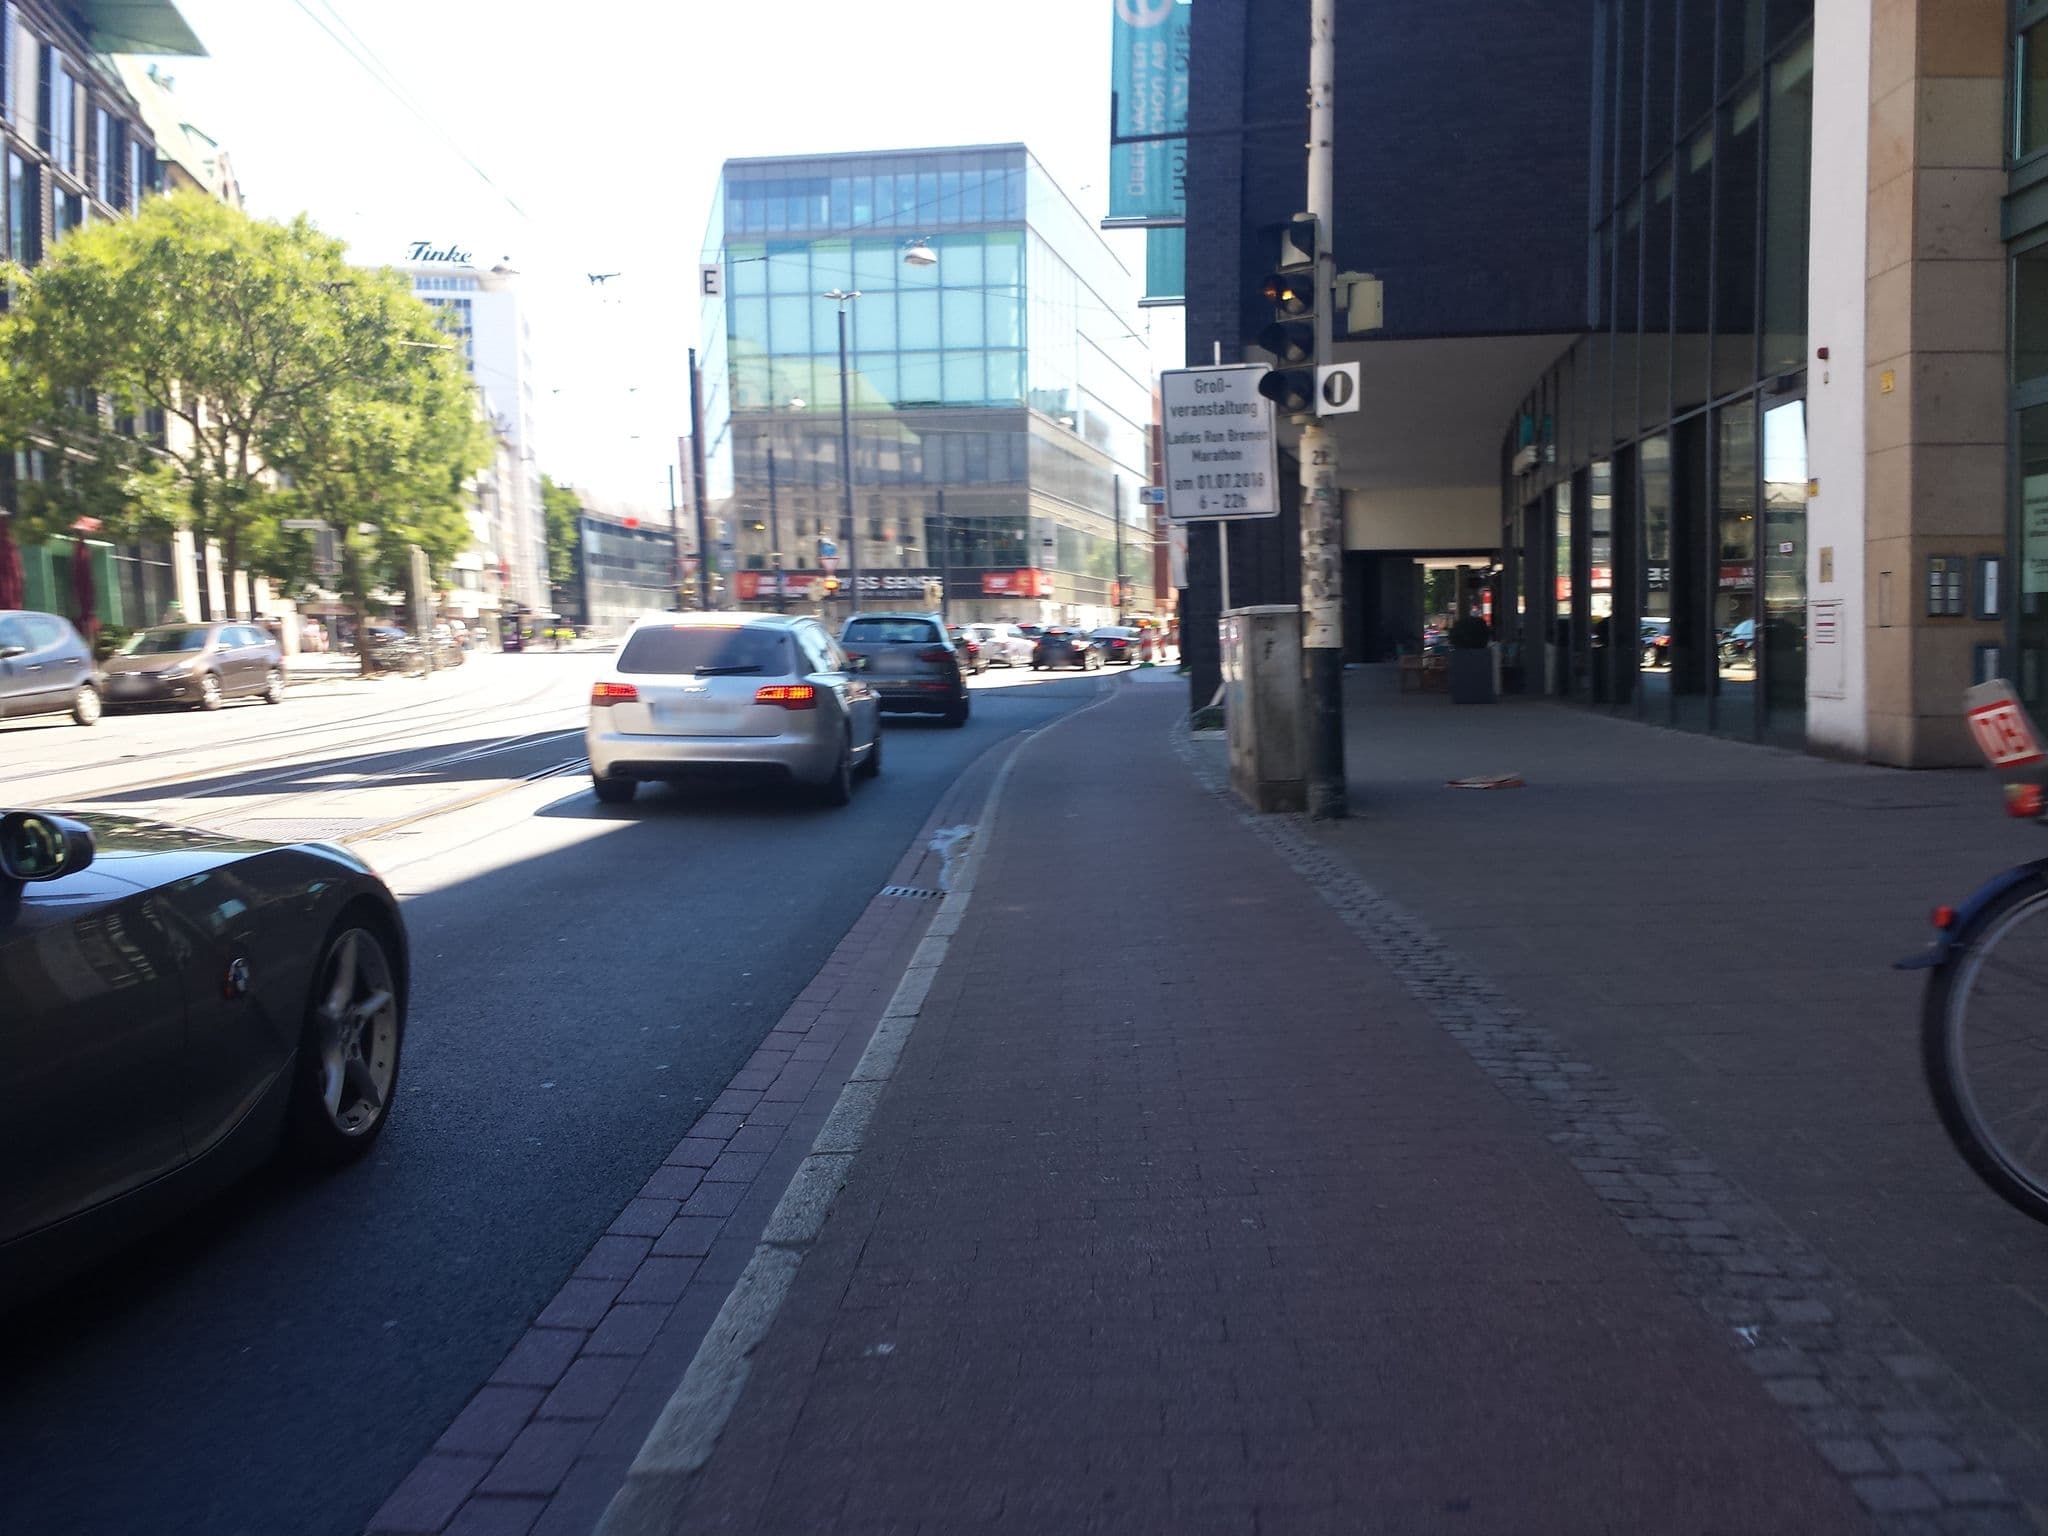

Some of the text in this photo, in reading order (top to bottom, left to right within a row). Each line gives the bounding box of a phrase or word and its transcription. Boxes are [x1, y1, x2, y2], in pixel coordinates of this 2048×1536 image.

[704, 270, 718, 294] E
[1170, 400, 1258, 418] veranstaltung
[1192, 448, 1242, 462] Marathon
[1175, 480, 1193, 491] am
